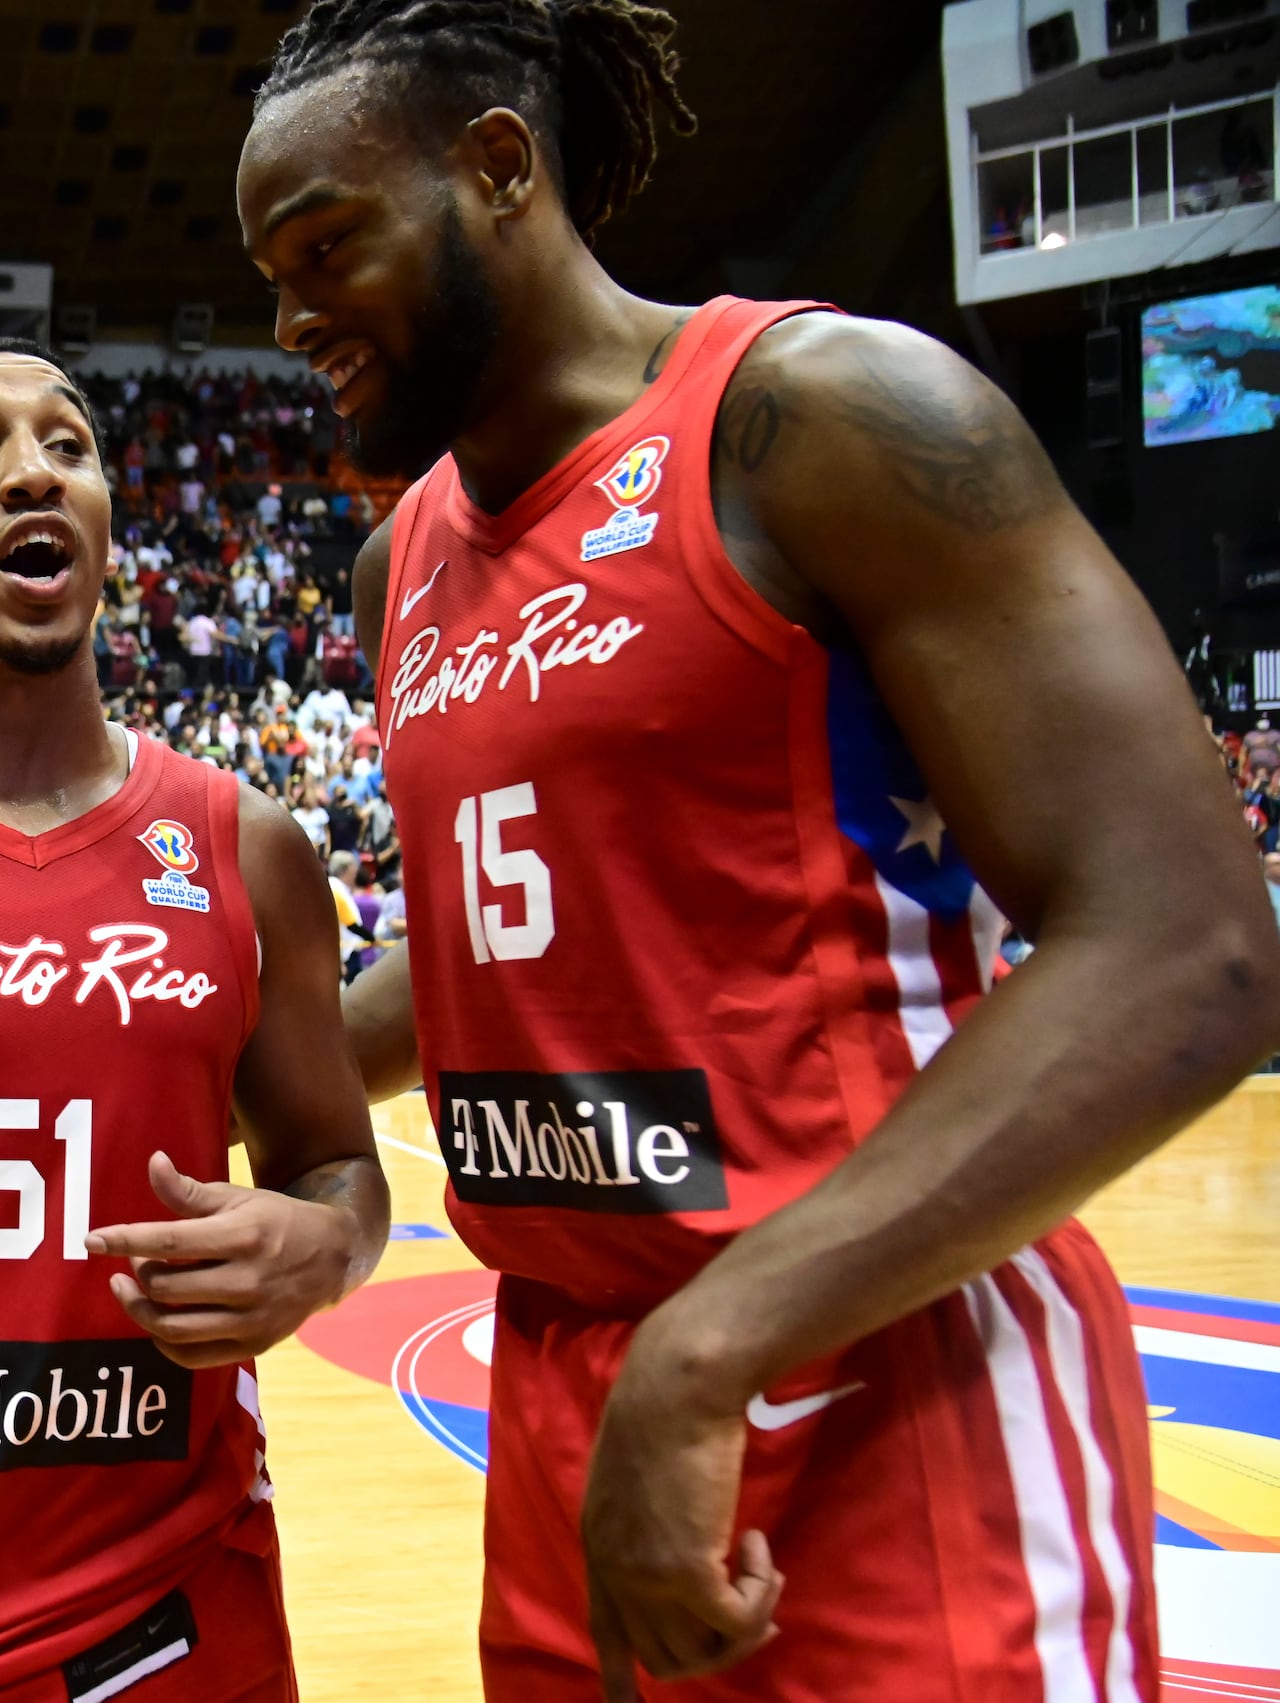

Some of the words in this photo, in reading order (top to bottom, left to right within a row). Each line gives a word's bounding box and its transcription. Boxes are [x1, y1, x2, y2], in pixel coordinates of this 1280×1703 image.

[385, 626, 498, 751] Puerto
[498, 583, 644, 702] Rico
[148, 886, 185, 897] WORLD
[187, 891, 206, 901] CUP
[151, 896, 207, 910] QUALIFIERS
[454, 781, 555, 965] 15
[75, 923, 218, 1026] Rico
[477, 1099, 690, 1186] Mobile
